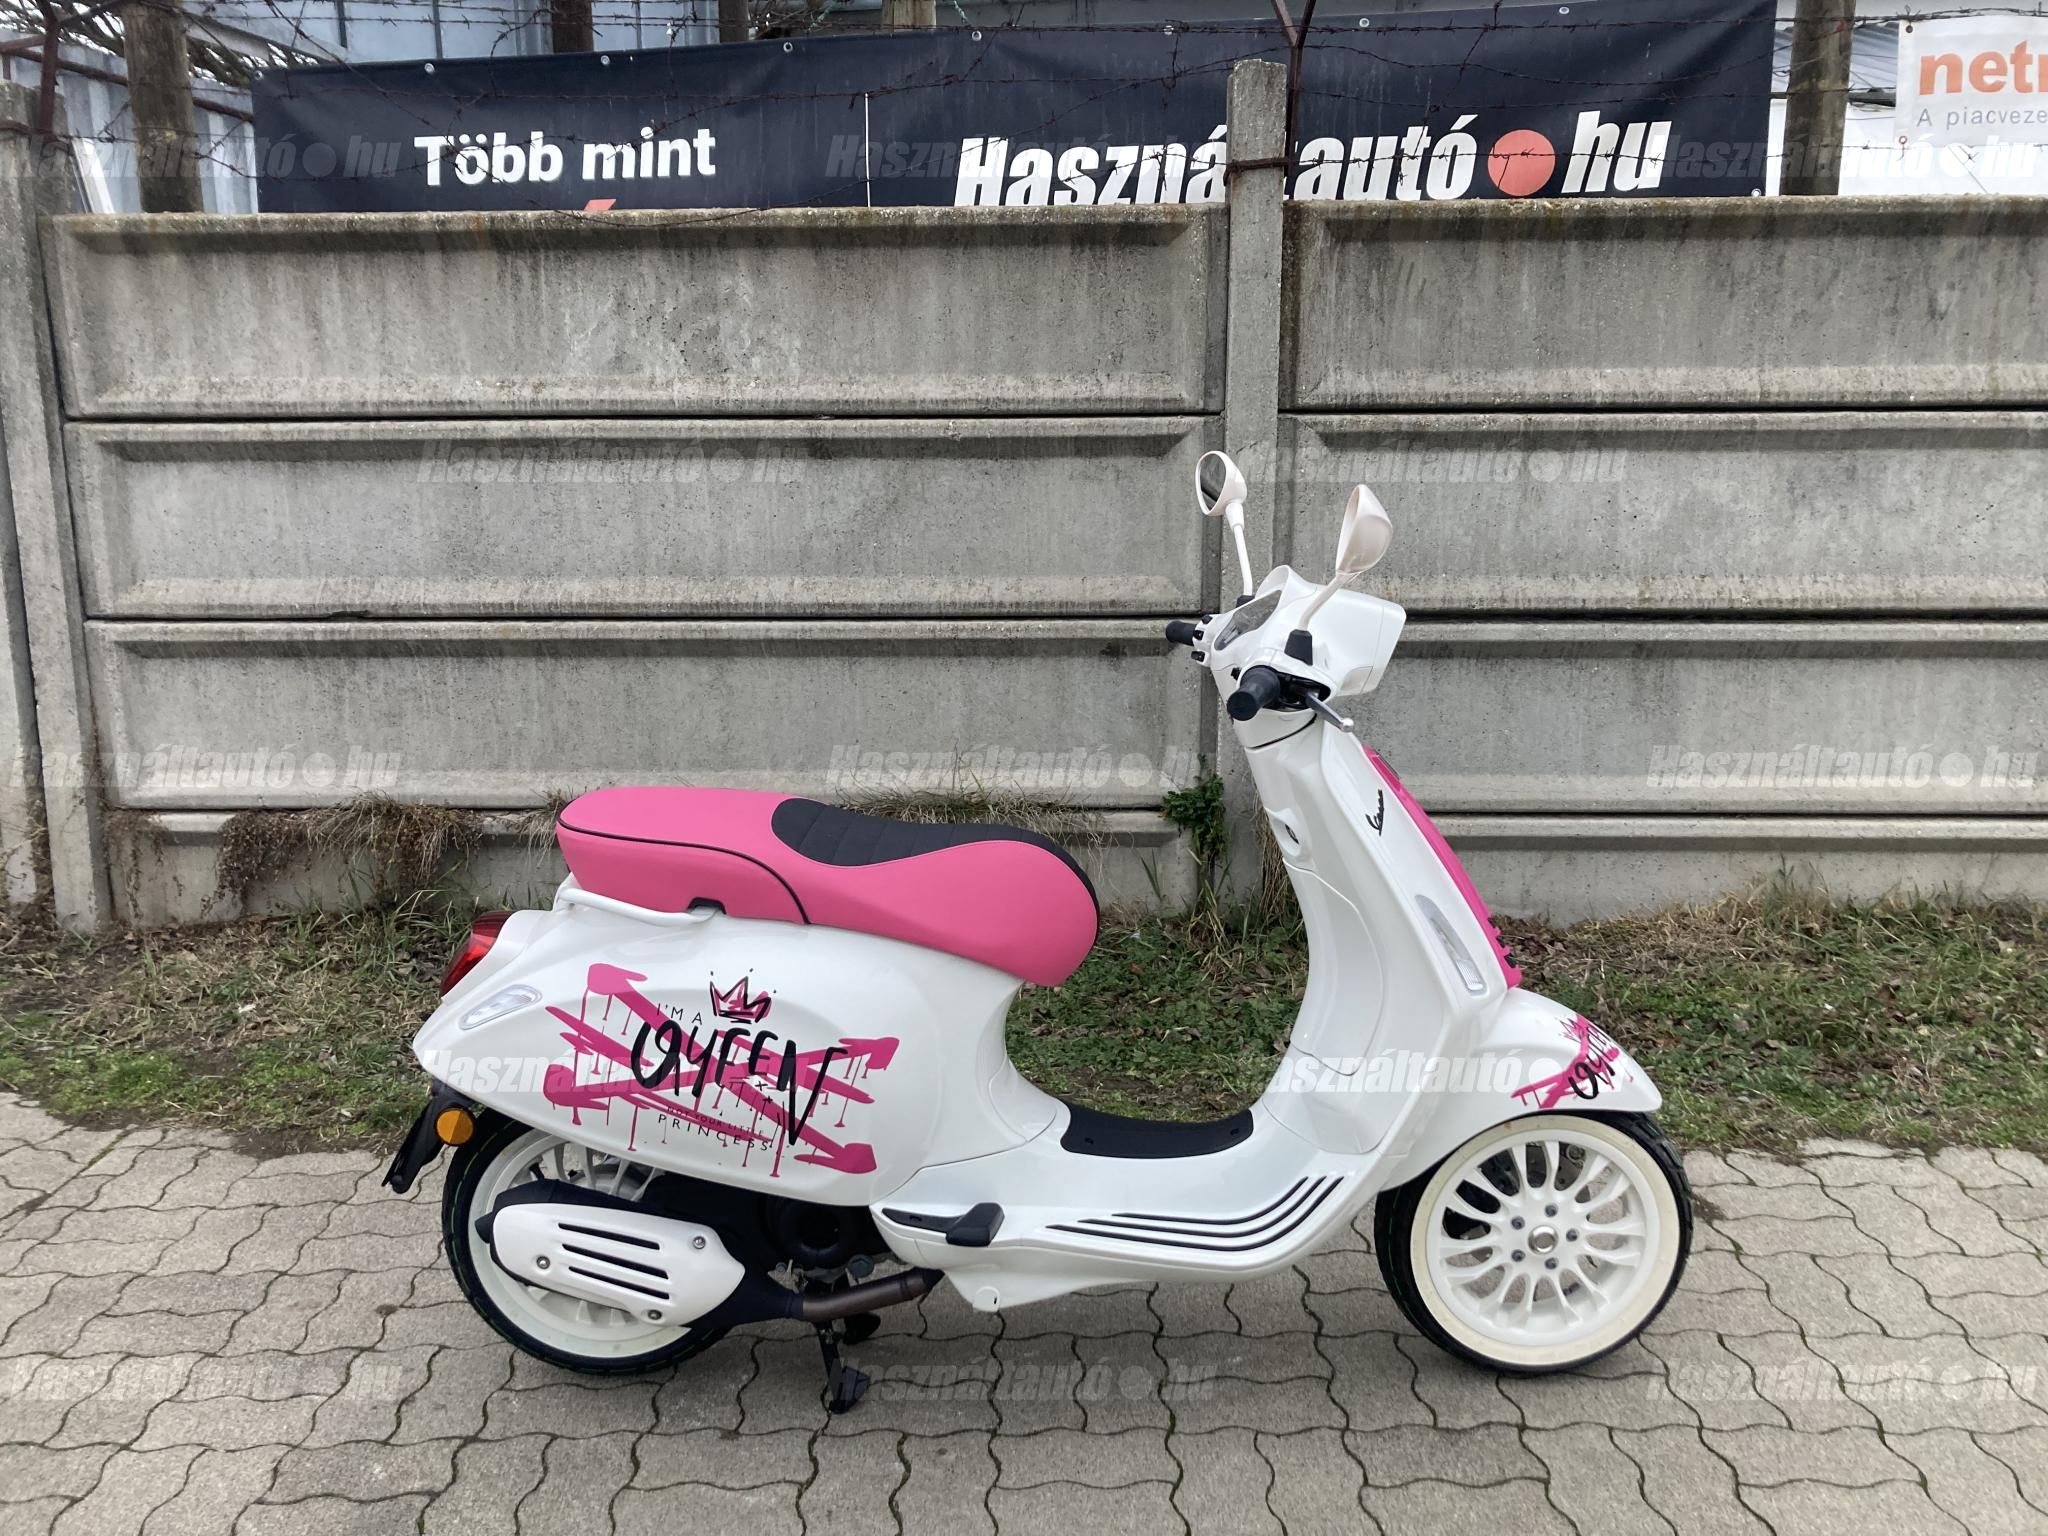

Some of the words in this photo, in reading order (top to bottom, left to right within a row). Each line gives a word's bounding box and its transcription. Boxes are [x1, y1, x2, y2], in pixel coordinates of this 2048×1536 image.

[1917, 108, 1933, 127] A
[414, 131, 564, 187] Több
[582, 126, 716, 181] mint
[954, 114, 1478, 207] Hasznáautó
[656, 1002, 684, 1021] I'M
[691, 1012, 703, 1026] A
[657, 1113, 769, 1152] PRINCESS
